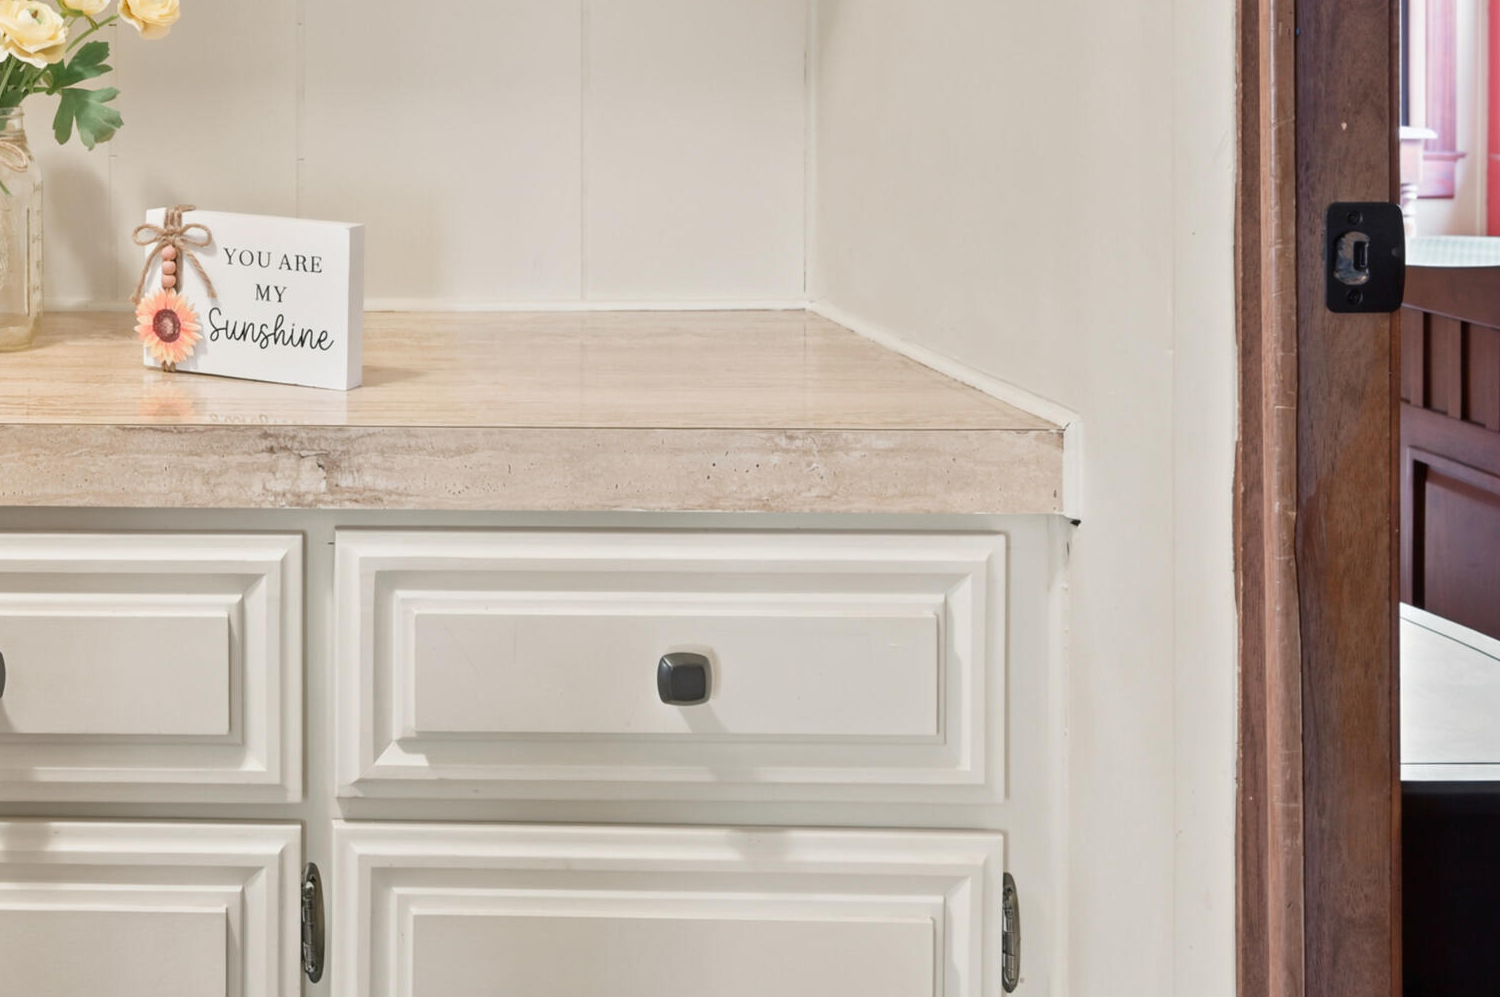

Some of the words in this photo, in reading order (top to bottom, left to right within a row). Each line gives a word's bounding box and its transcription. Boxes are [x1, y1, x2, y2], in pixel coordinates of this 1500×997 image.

[223, 247, 271, 268] YOU
[278, 253, 323, 273] ARE
[255, 283, 287, 303] MY
[208, 307, 334, 351] Sunshine
